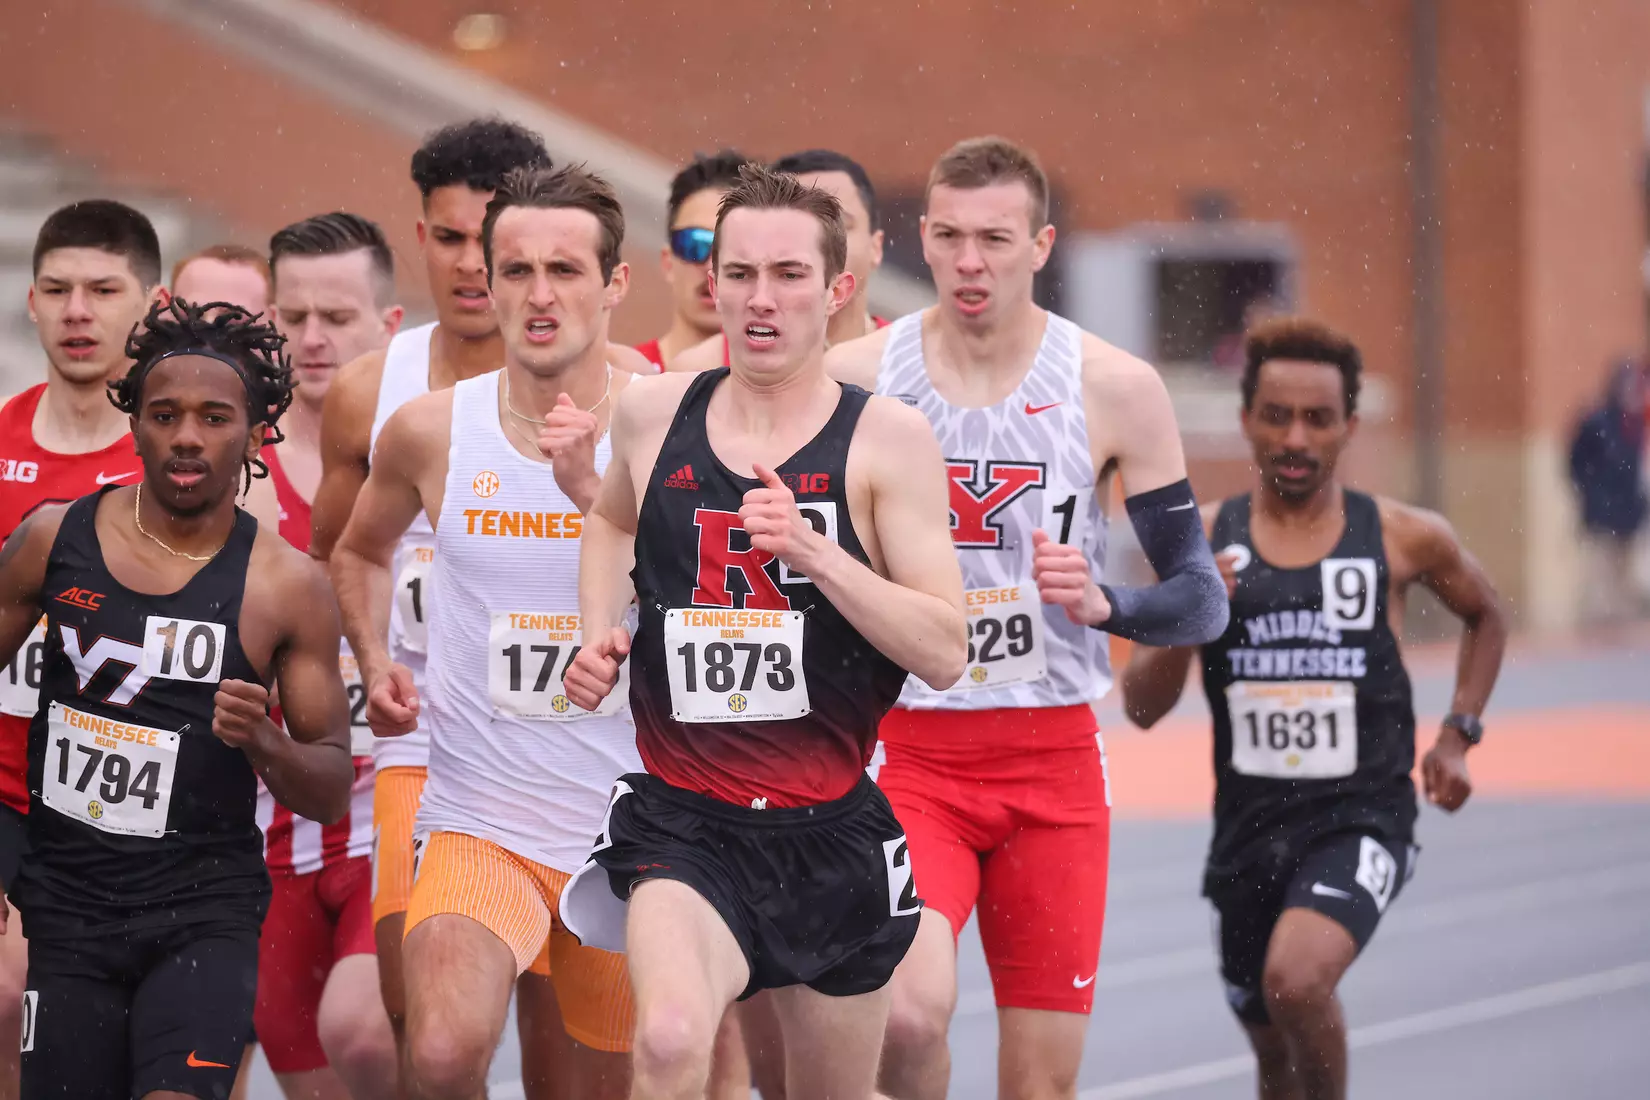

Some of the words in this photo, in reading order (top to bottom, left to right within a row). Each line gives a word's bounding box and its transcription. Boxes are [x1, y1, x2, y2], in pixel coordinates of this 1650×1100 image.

[473, 471, 499, 498] SEC
[664, 477, 699, 490] adidas
[944, 458, 1046, 550] Y
[1053, 495, 1077, 544] 1
[691, 508, 791, 611] R
[56, 586, 106, 611] ACC
[1334, 567, 1367, 621] 9
[683, 611, 783, 627] TENNESSEE
[720, 630, 744, 638] RELAYS
[157, 621, 216, 679] 10
[549, 632, 573, 641] RELAYS
[677, 642, 795, 693] 1873
[1227, 648, 1367, 677] TENNESSEE
[728, 693, 747, 712] SEC
[63, 707, 159, 746] TENNESSEE
[94, 736, 117, 749] RELAYS
[1244, 710, 1338, 750] 1631
[56, 737, 161, 810] 1794
[88, 801, 103, 818] SEC
[893, 841, 919, 911] 2
